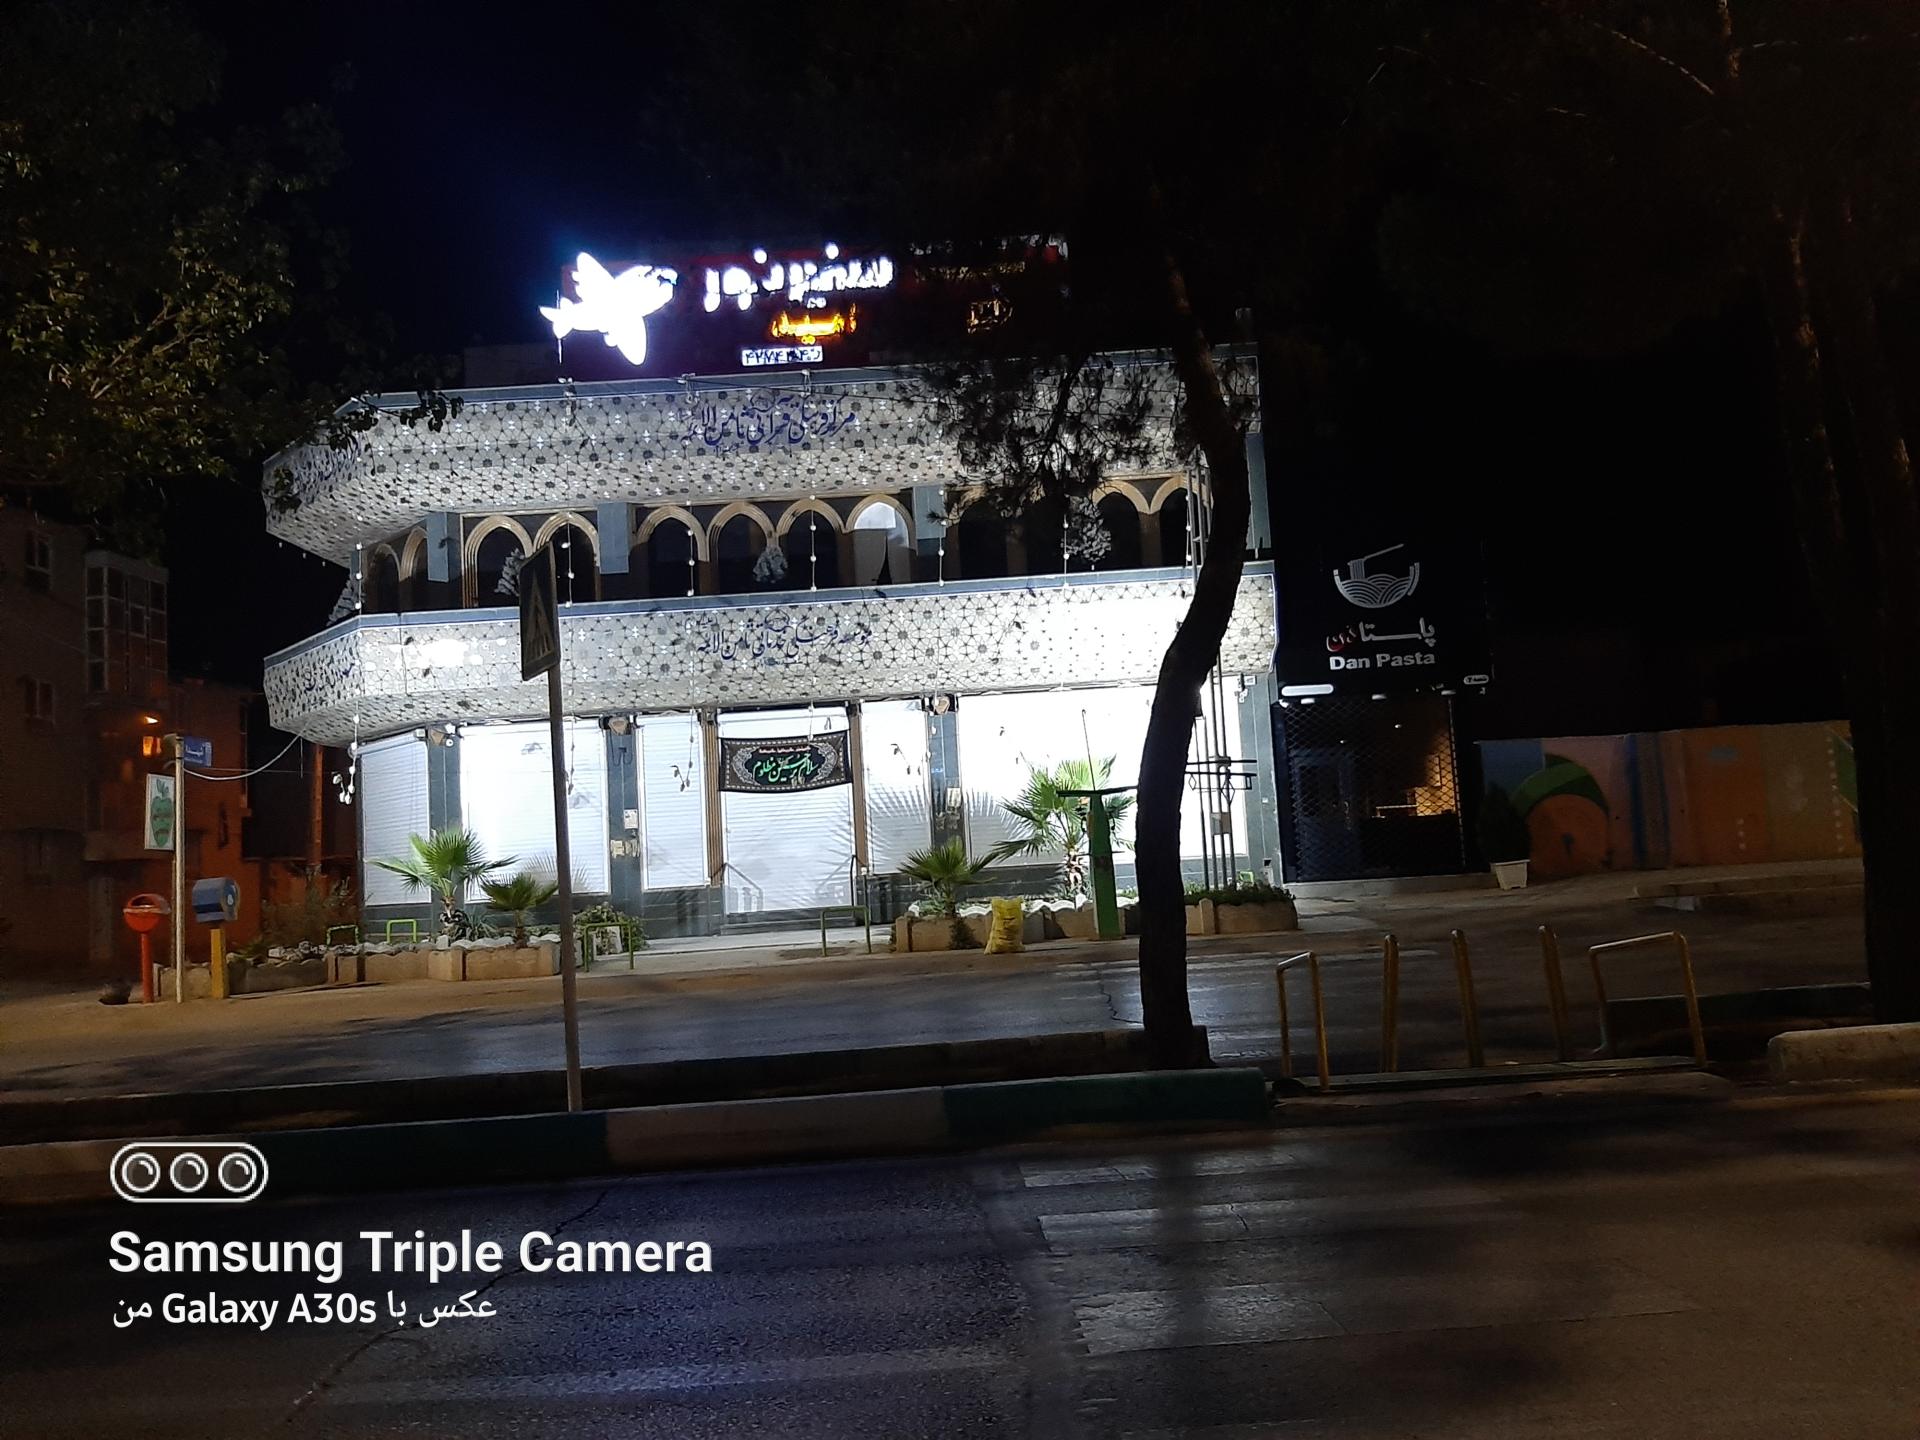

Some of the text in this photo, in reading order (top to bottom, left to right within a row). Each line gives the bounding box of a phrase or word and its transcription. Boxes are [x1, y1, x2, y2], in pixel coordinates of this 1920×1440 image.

[1358, 617, 1437, 648] پاستا
[1329, 652, 1436, 671] Dan Pasta
